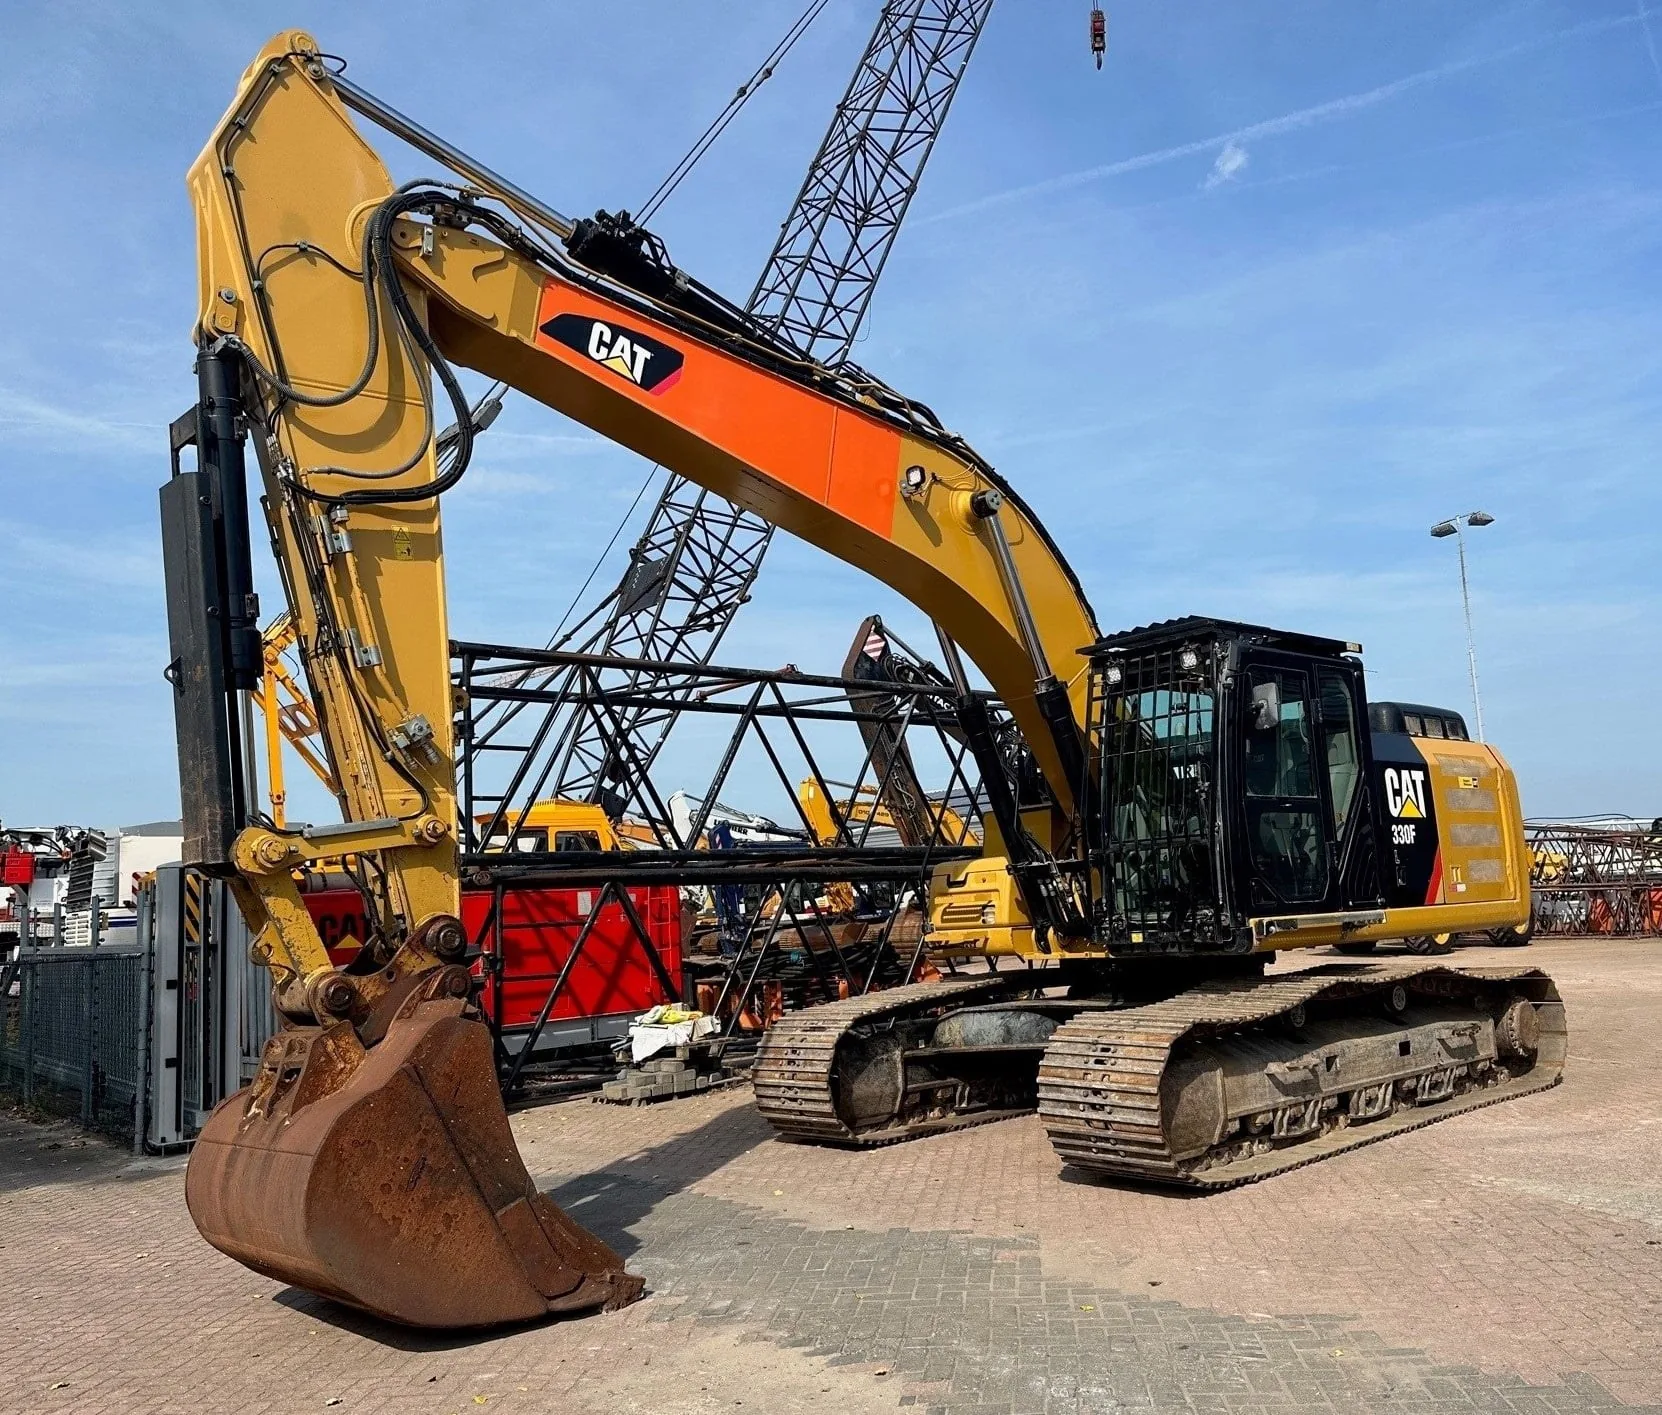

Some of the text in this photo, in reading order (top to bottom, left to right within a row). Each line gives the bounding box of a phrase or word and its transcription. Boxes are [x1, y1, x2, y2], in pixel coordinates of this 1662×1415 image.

[588, 322, 650, 384] CAT
[1384, 767, 1427, 818] CAT
[1391, 824, 1416, 845] 330F
